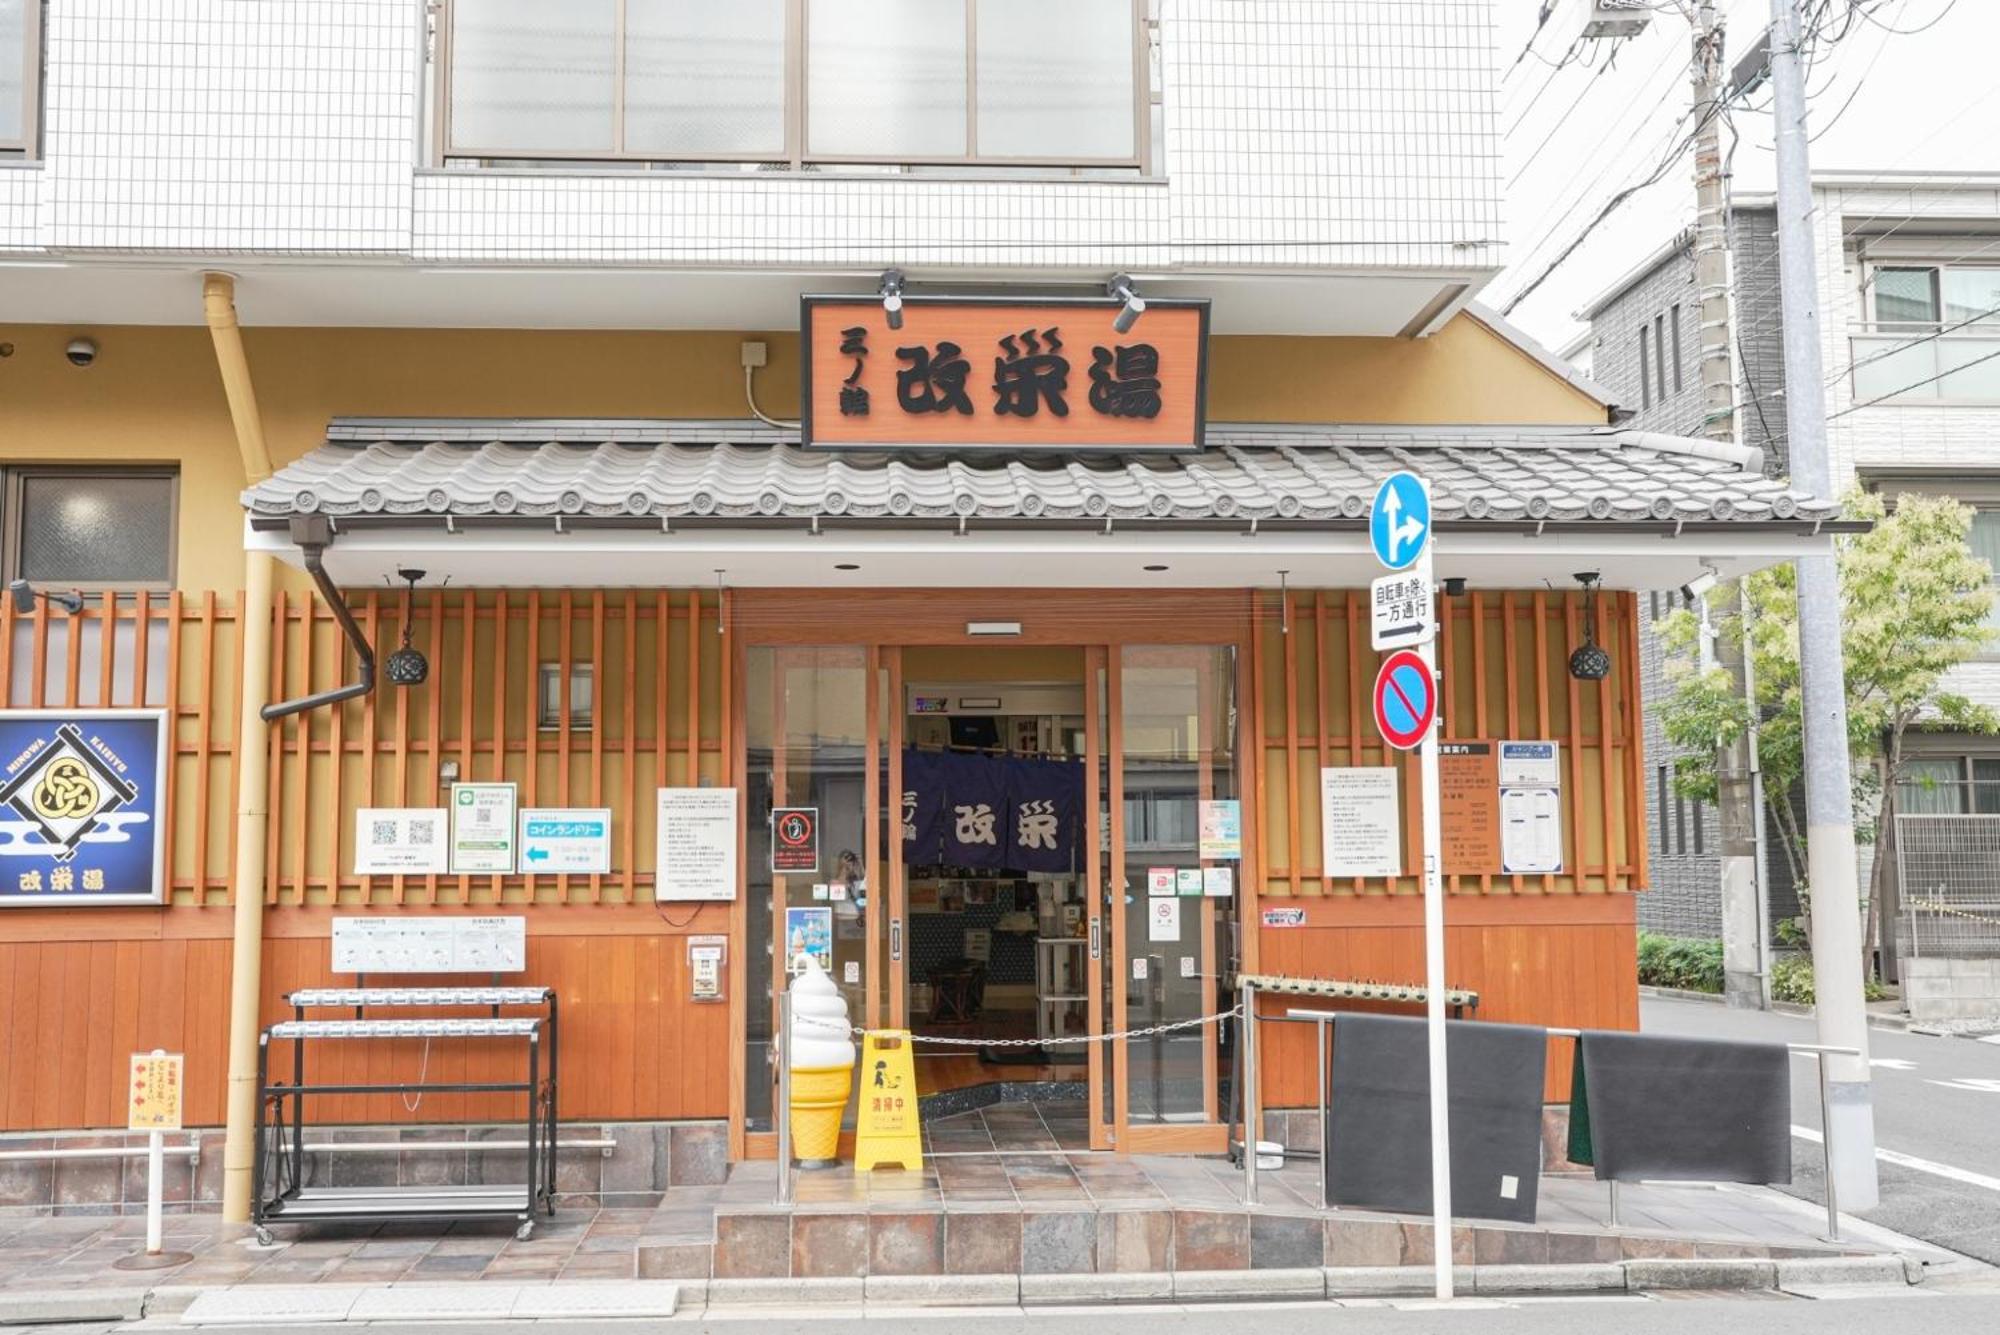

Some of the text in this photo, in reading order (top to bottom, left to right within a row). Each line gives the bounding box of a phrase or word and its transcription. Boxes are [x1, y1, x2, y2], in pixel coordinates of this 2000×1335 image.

[838, 326, 870, 416] 三ノ輪
[1376, 578, 1427, 604] 自転車を除く
[1376, 598, 1427, 623] 一方通行
[7, 738, 46, 773] MINOWA
[530, 825, 601, 836] コインランドリー
